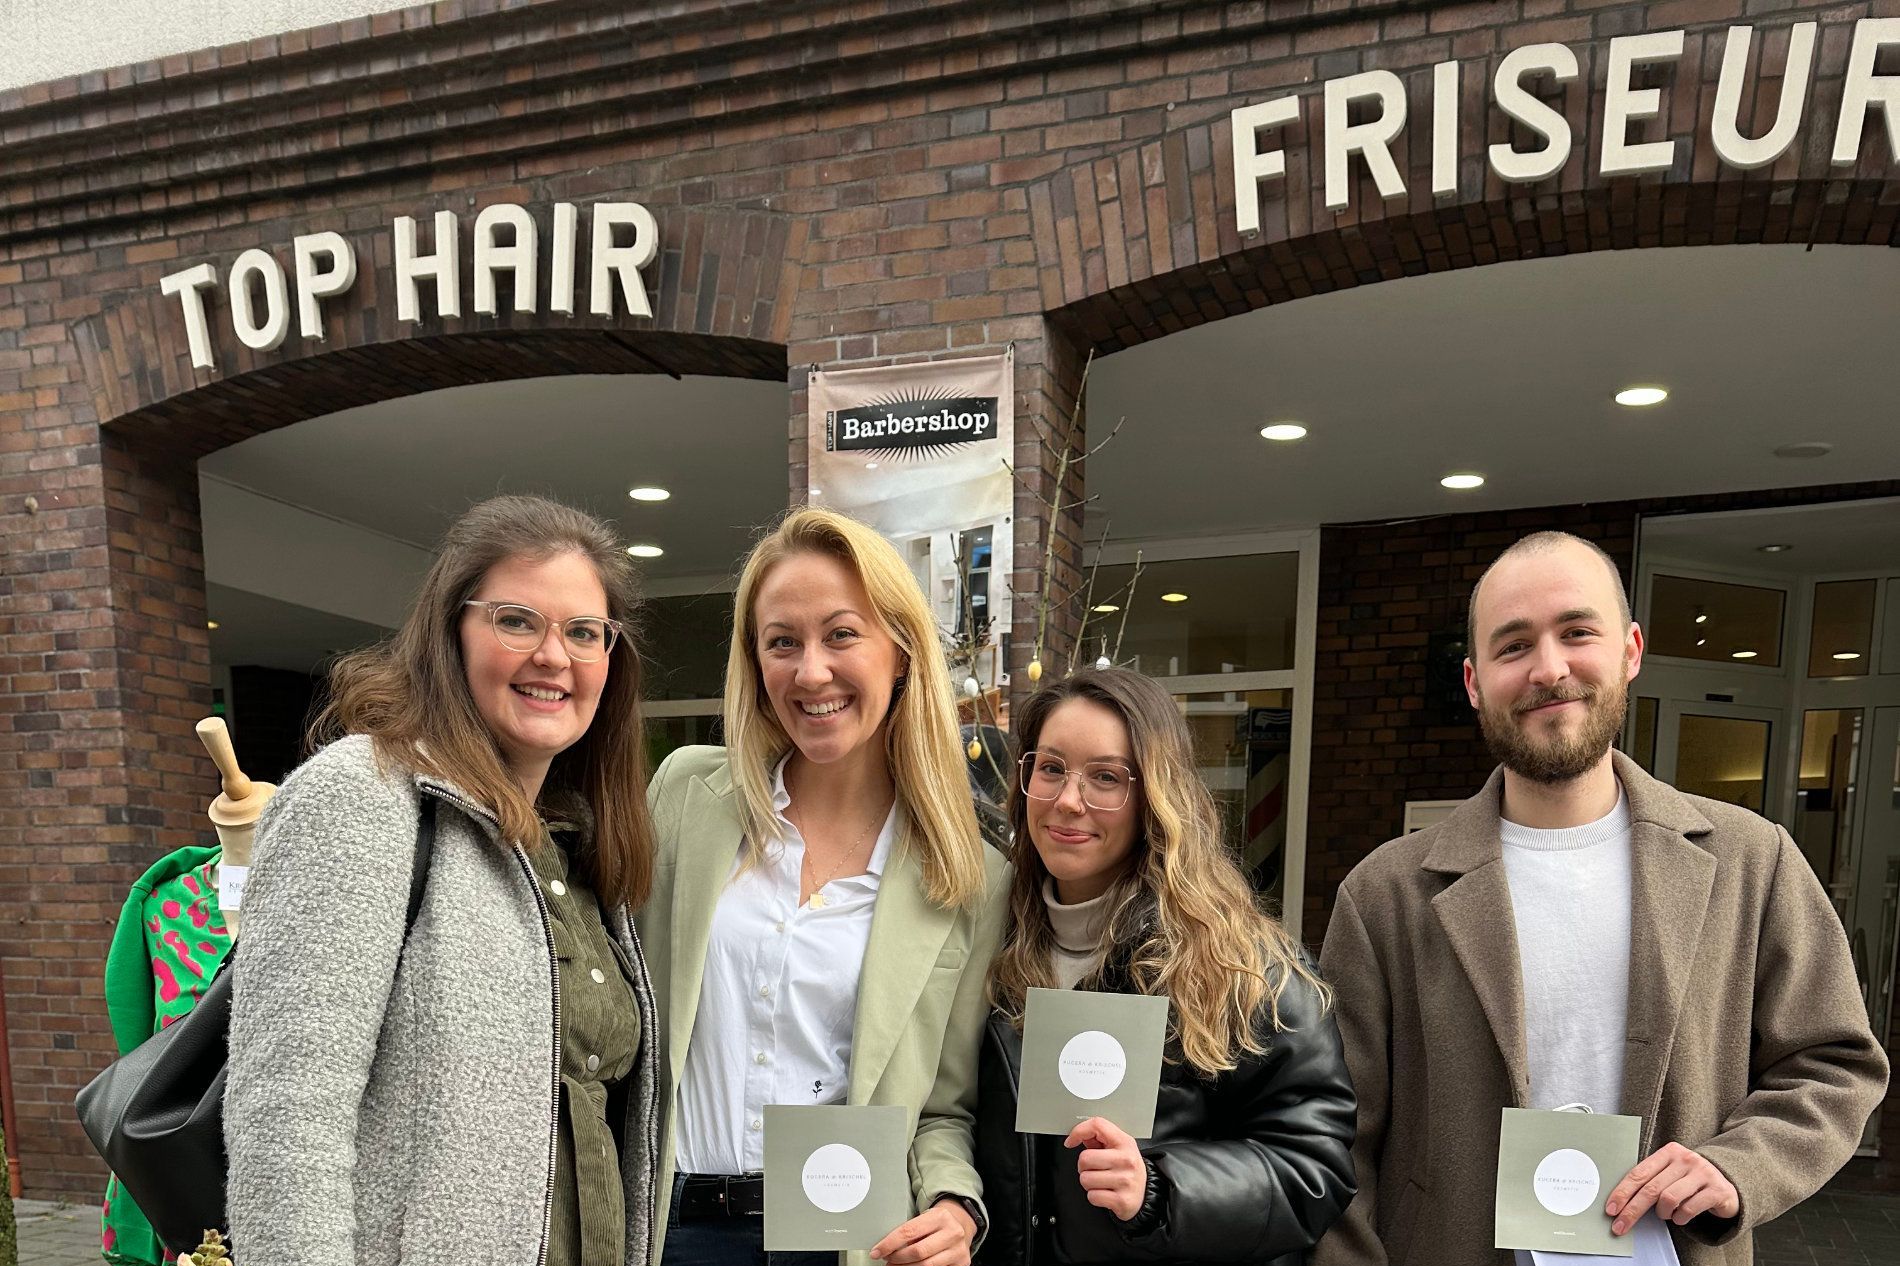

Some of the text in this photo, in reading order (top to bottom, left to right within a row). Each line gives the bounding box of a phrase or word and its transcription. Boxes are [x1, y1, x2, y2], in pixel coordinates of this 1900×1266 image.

[1231, 17, 1900, 236] FRISEUR
[160, 203, 658, 369] TOP HAIR
[842, 409, 990, 440] Barbershop
